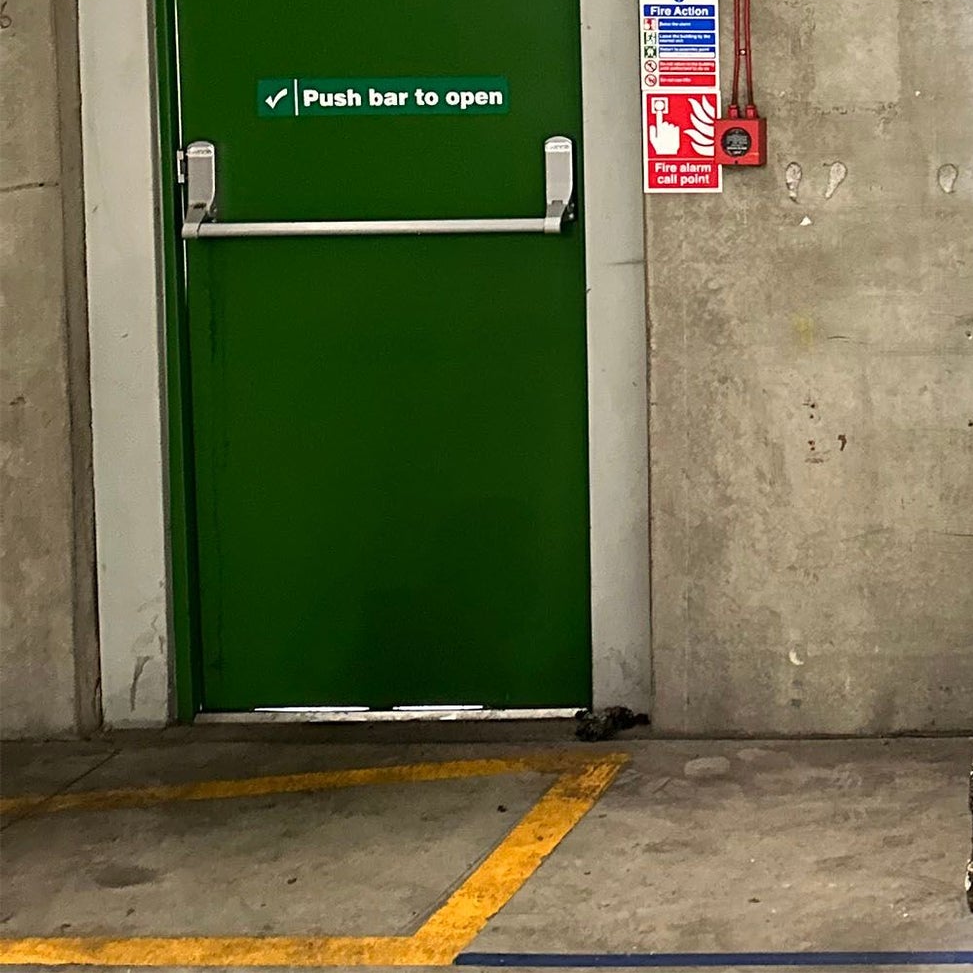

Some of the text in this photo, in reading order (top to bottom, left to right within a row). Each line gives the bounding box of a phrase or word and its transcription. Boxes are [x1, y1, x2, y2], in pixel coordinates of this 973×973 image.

[650, 6, 709, 16] Fire Action
[303, 88, 503, 109] Push bar to open
[655, 163, 711, 173] Fire alarm
[657, 174, 710, 187] call point
